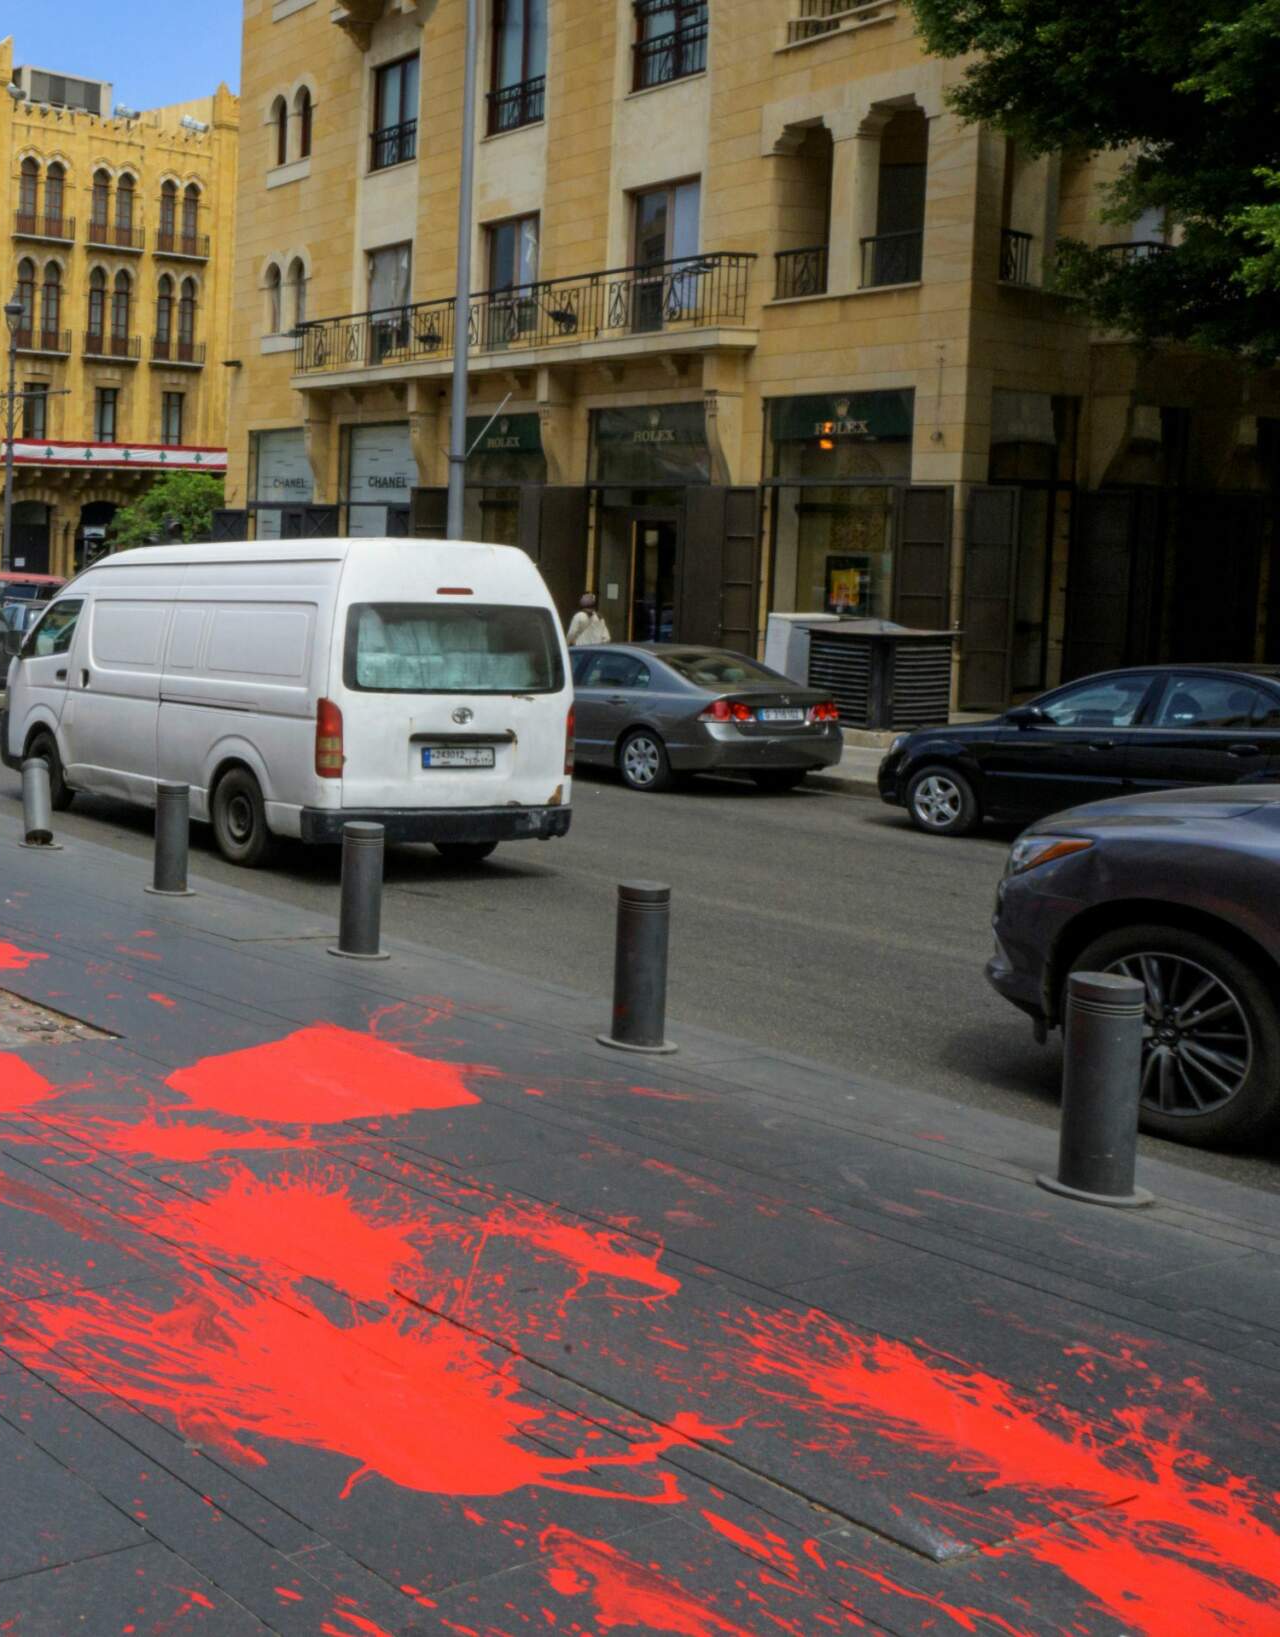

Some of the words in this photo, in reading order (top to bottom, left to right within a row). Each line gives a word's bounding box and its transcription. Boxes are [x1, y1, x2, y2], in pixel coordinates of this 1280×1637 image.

[633, 429, 676, 442] ROLEX
[487, 436, 520, 448] ROLEX
[273, 478, 305, 488] CHANEL
[367, 475, 407, 488] CHANEL
